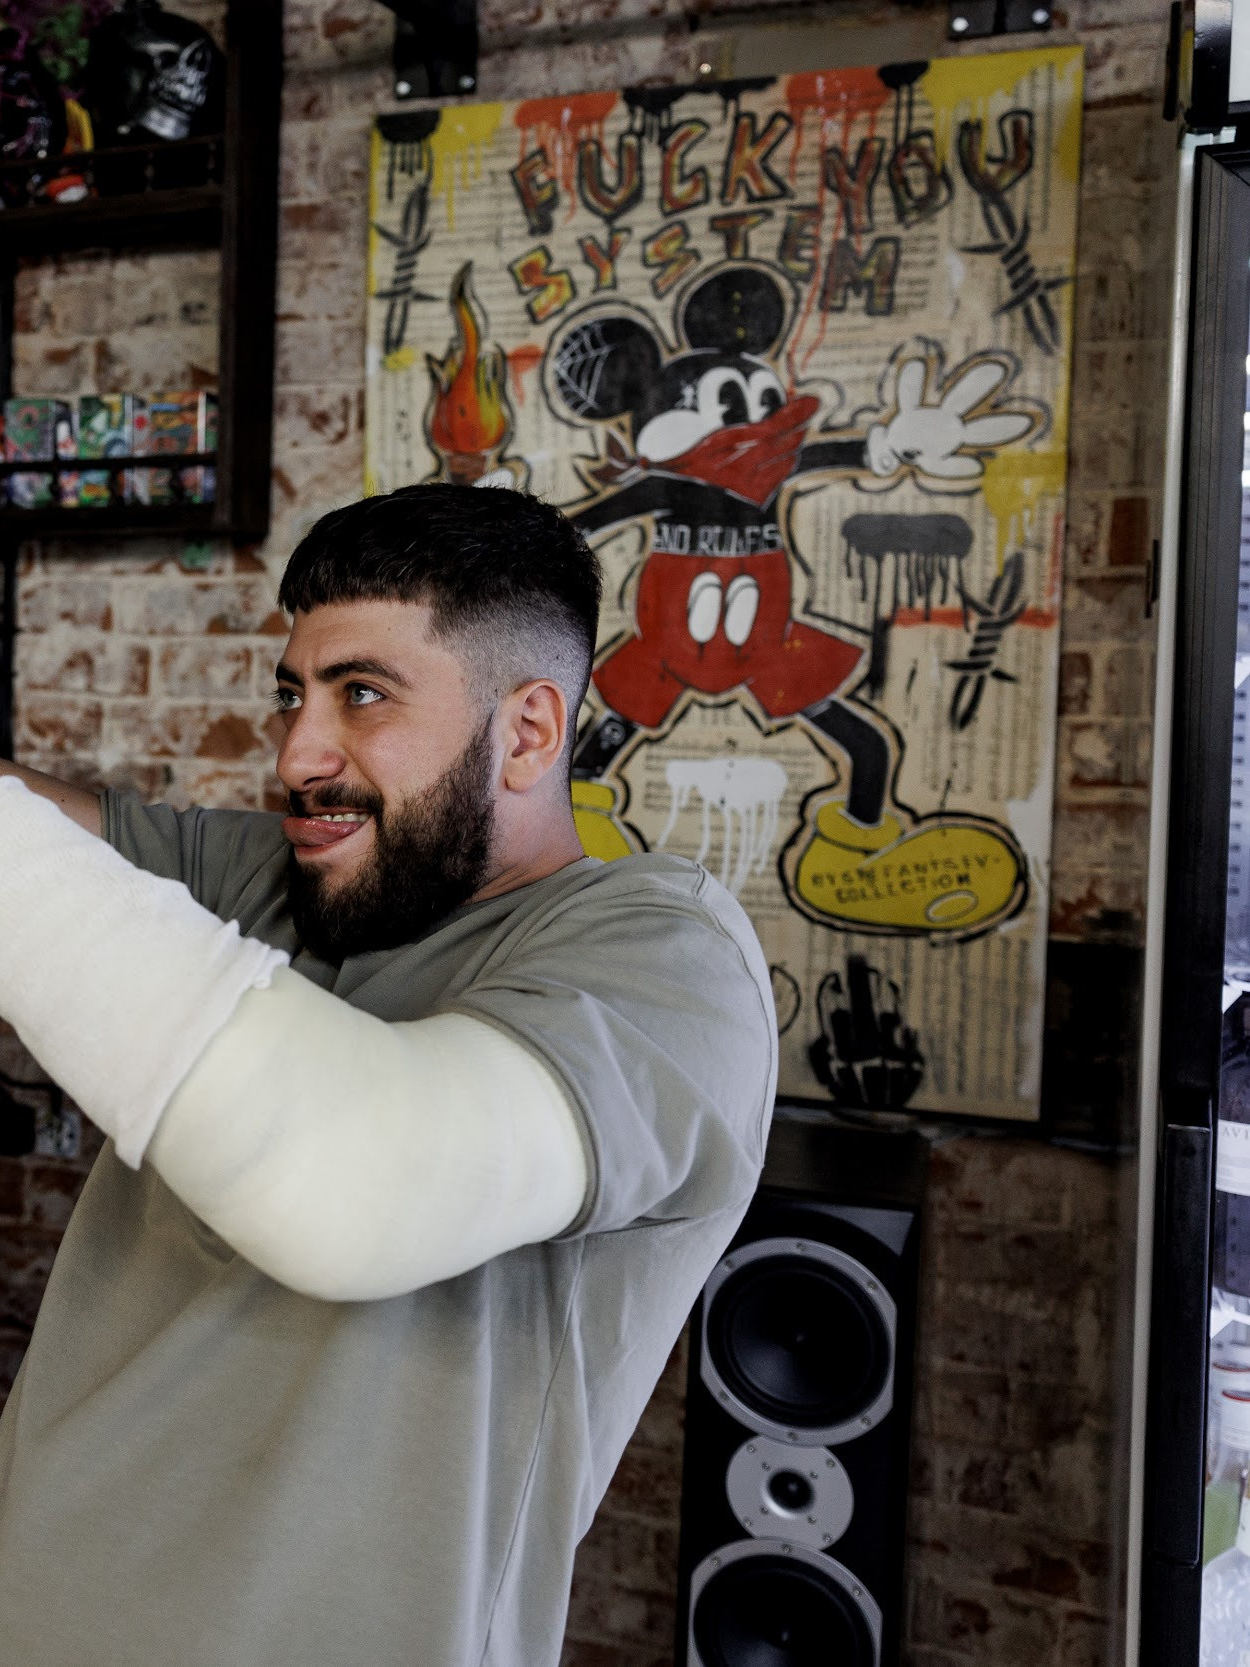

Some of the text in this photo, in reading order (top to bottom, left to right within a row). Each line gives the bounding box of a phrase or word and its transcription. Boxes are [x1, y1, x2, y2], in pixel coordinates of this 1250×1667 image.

[510, 109, 797, 235] FUCK
[509, 204, 902, 320] SYSTEM
[652, 523, 691, 555] NO
